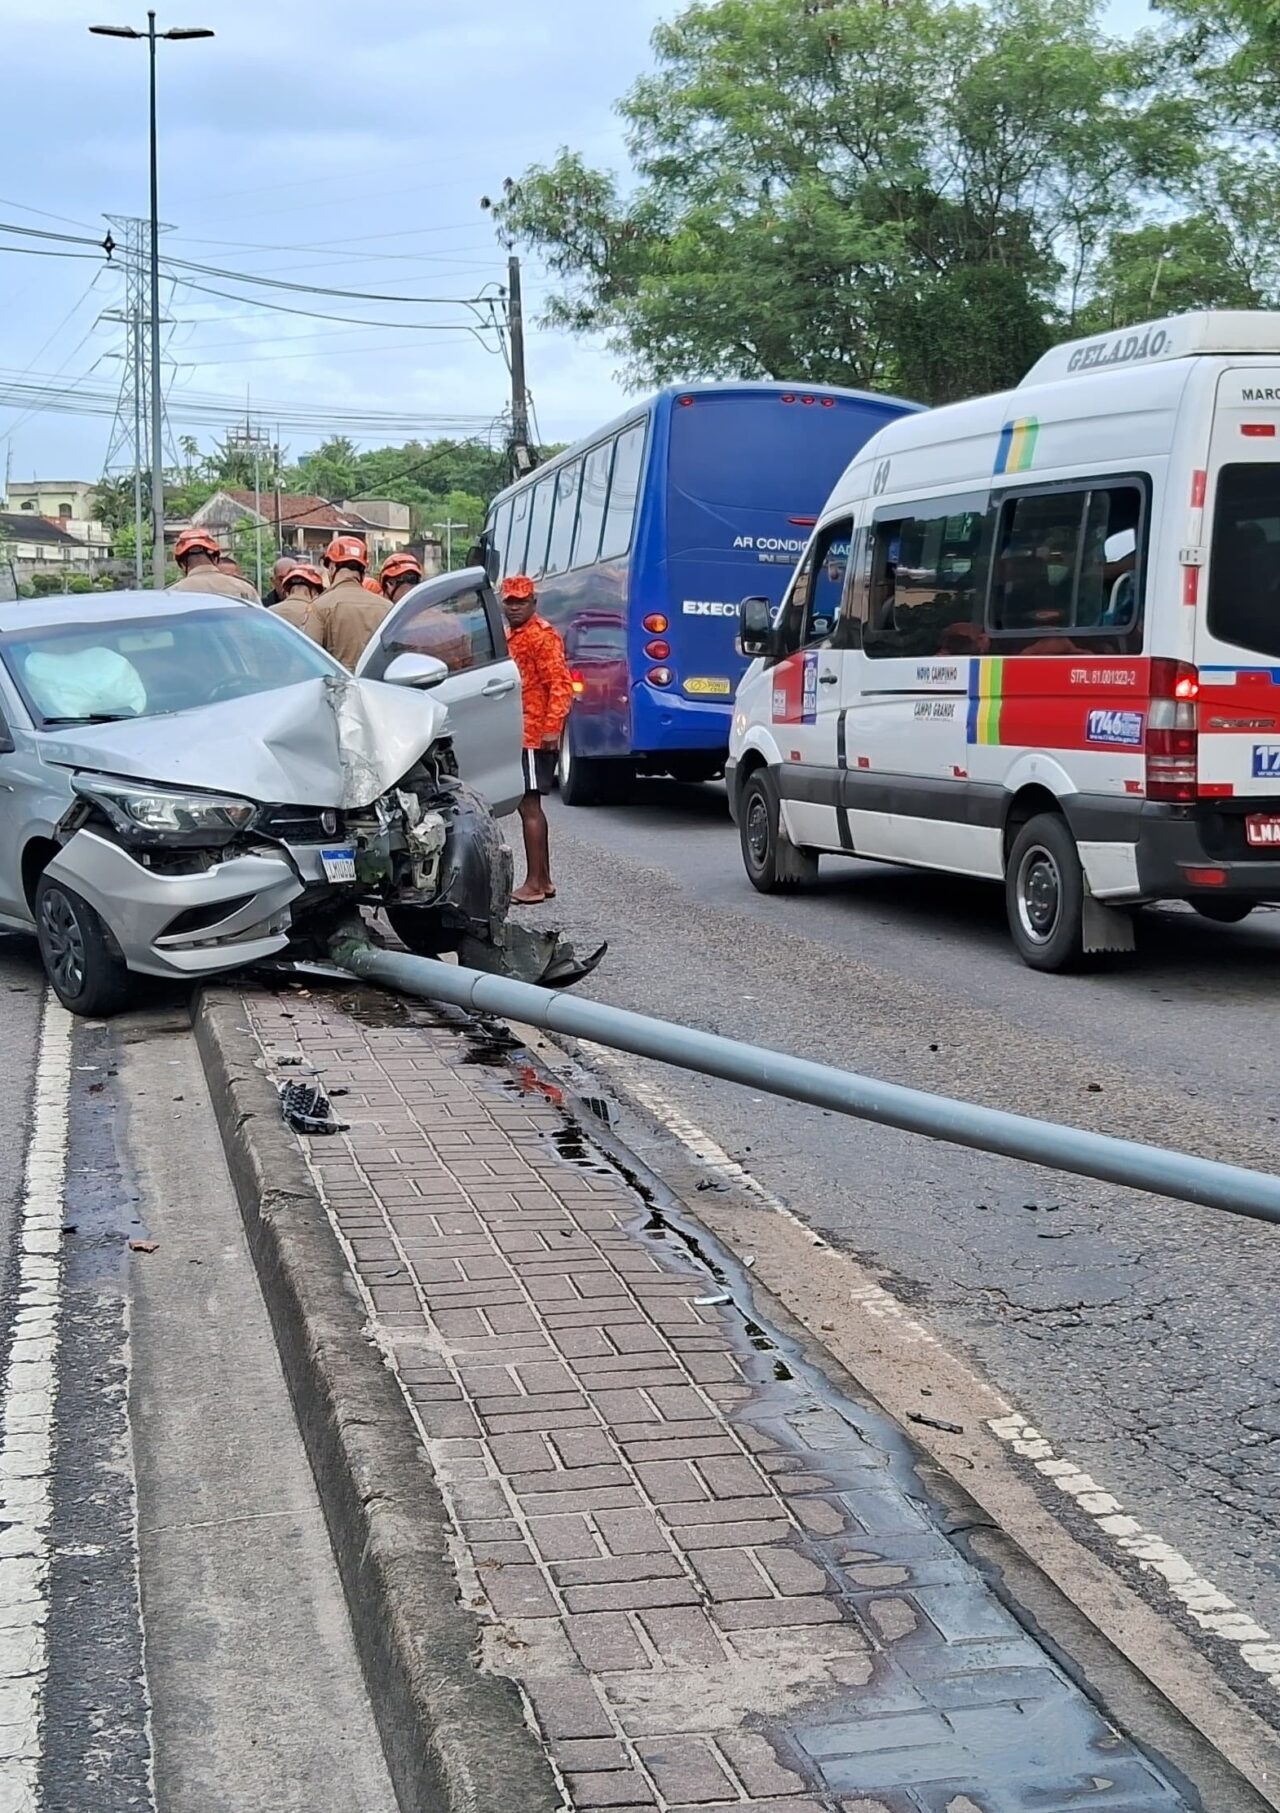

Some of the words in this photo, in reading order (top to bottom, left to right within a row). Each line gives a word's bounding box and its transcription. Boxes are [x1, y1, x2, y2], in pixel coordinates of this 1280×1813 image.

[733, 536, 753, 549] AR
[913, 702, 932, 717] CAMPO
[933, 703, 955, 718] GRANDE
[1089, 710, 1122, 736] 1746
